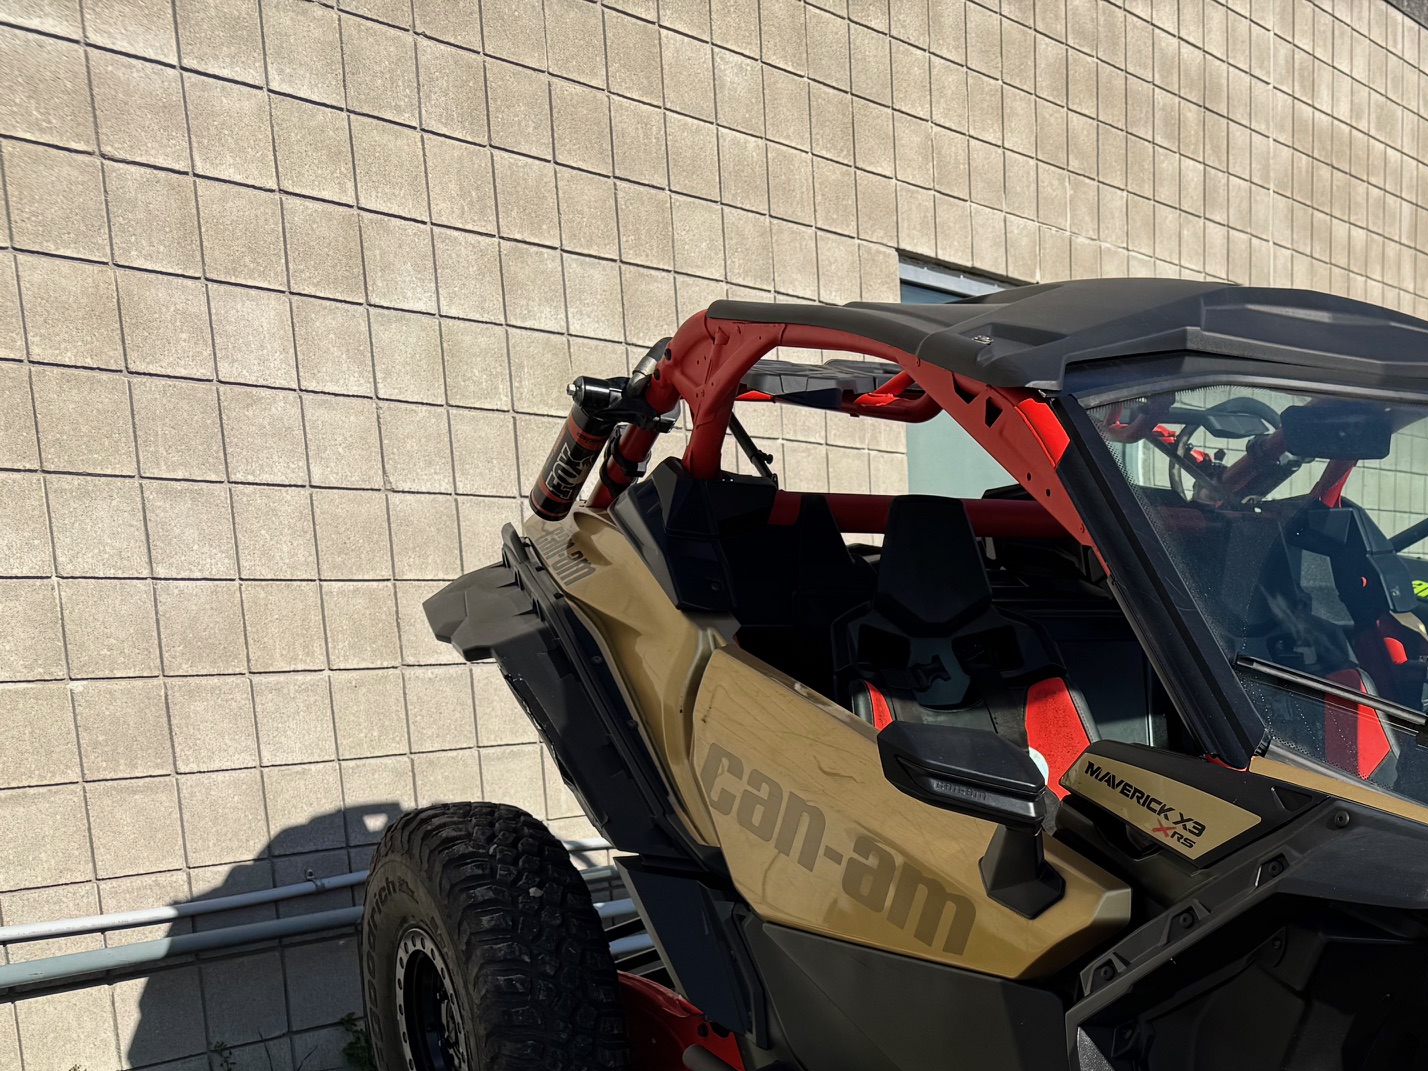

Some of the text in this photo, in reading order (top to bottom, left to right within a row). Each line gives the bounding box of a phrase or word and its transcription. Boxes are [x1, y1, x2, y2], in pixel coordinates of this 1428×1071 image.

[546, 441, 591, 500] FOX
[1084, 760, 1207, 838] MAVERICK X3
[700, 742, 977, 957] can-am
